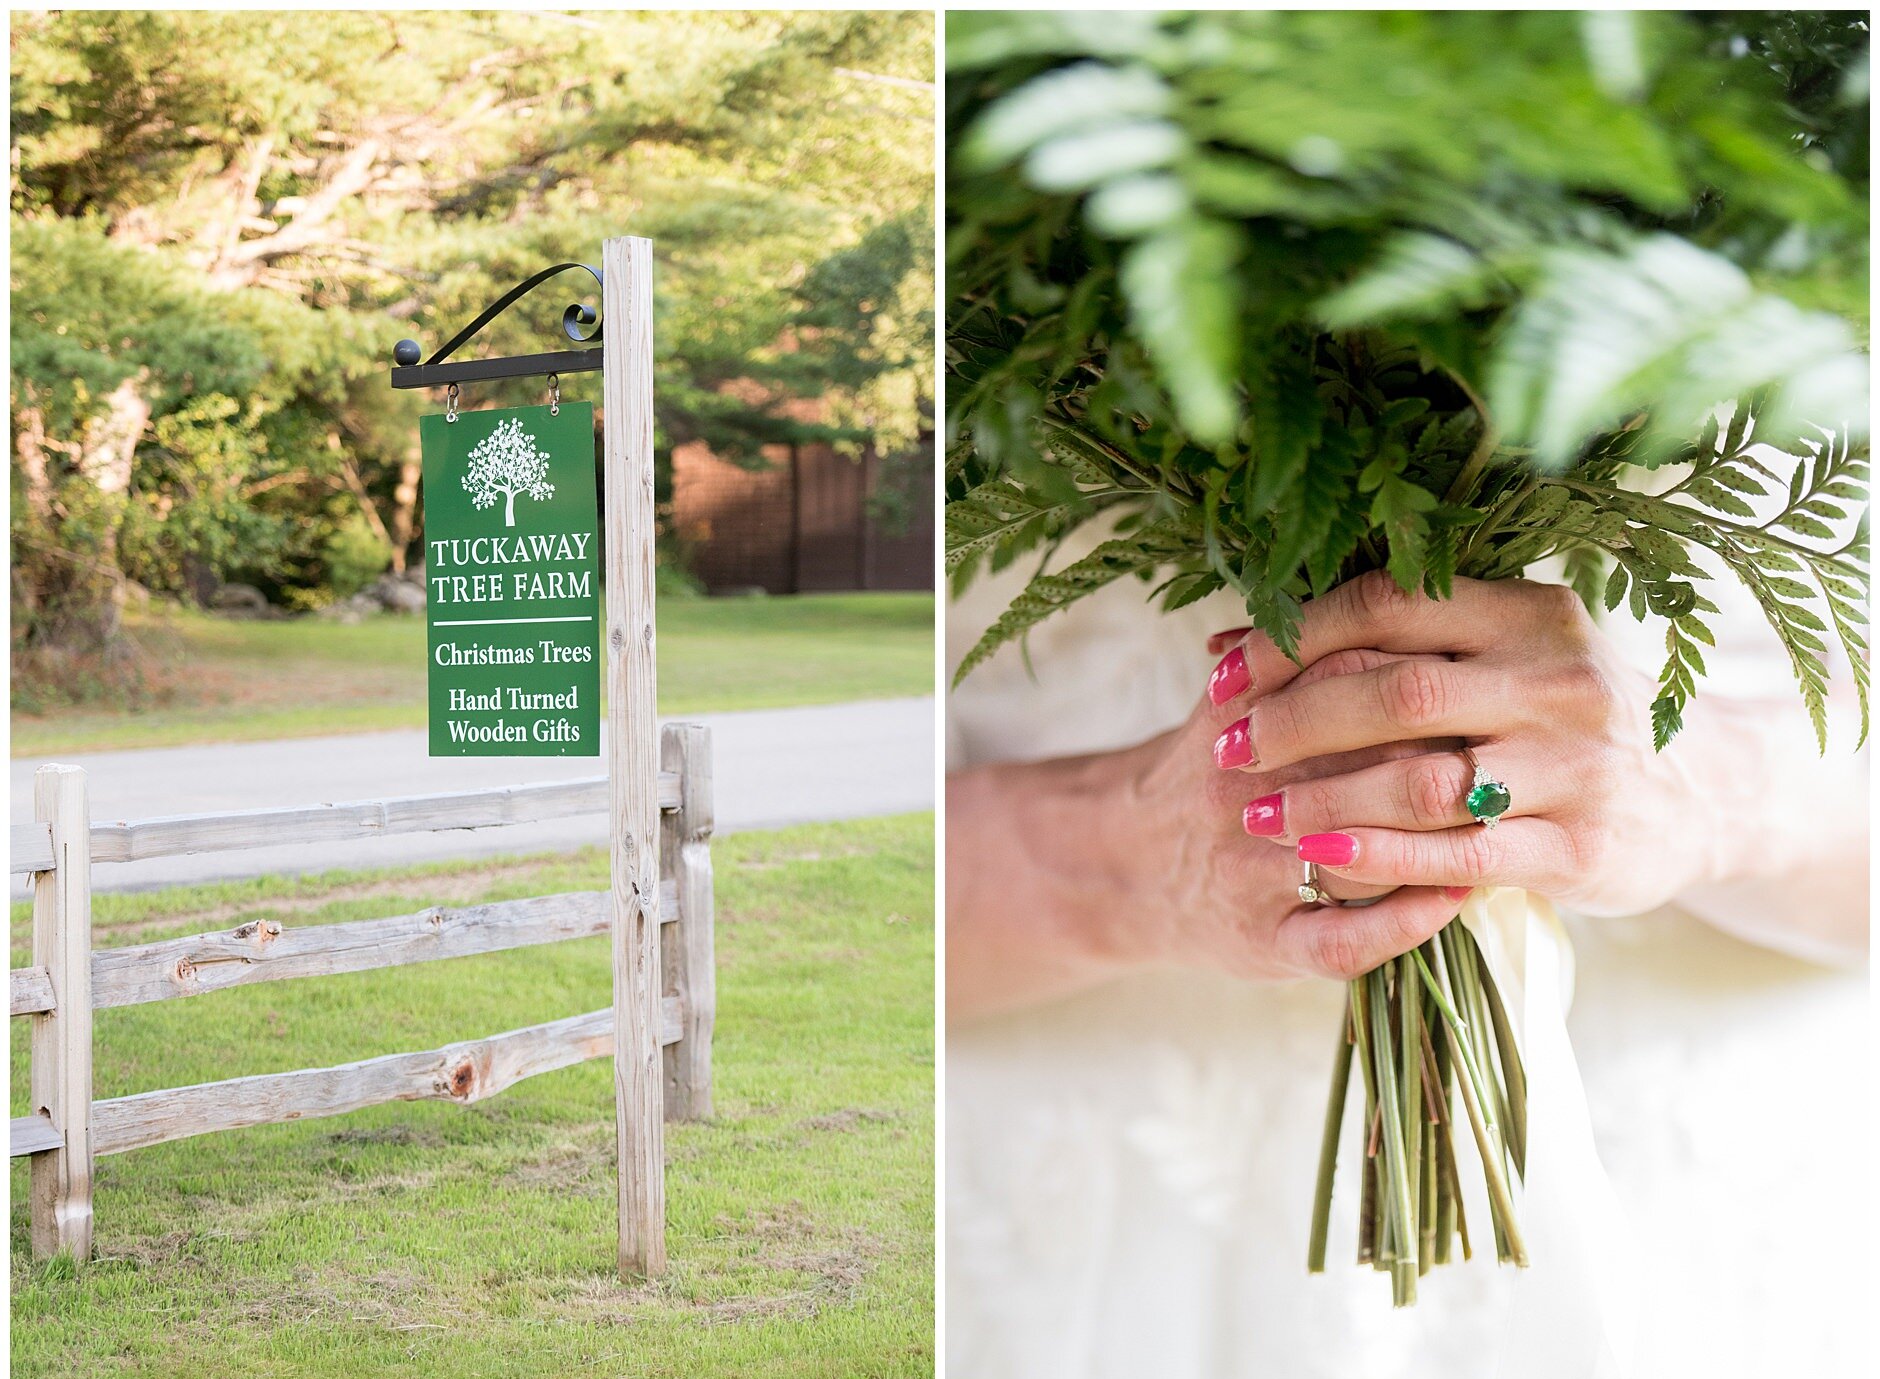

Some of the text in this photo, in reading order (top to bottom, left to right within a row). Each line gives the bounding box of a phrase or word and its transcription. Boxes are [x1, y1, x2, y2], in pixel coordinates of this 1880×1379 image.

[431, 533, 592, 567] TUCKAWAY
[431, 571, 592, 603] TREE FARM
[434, 640, 592, 666] Christmas Trees
[448, 686, 579, 711] Hand Turned
[447, 718, 580, 743] Wooden Gifts
